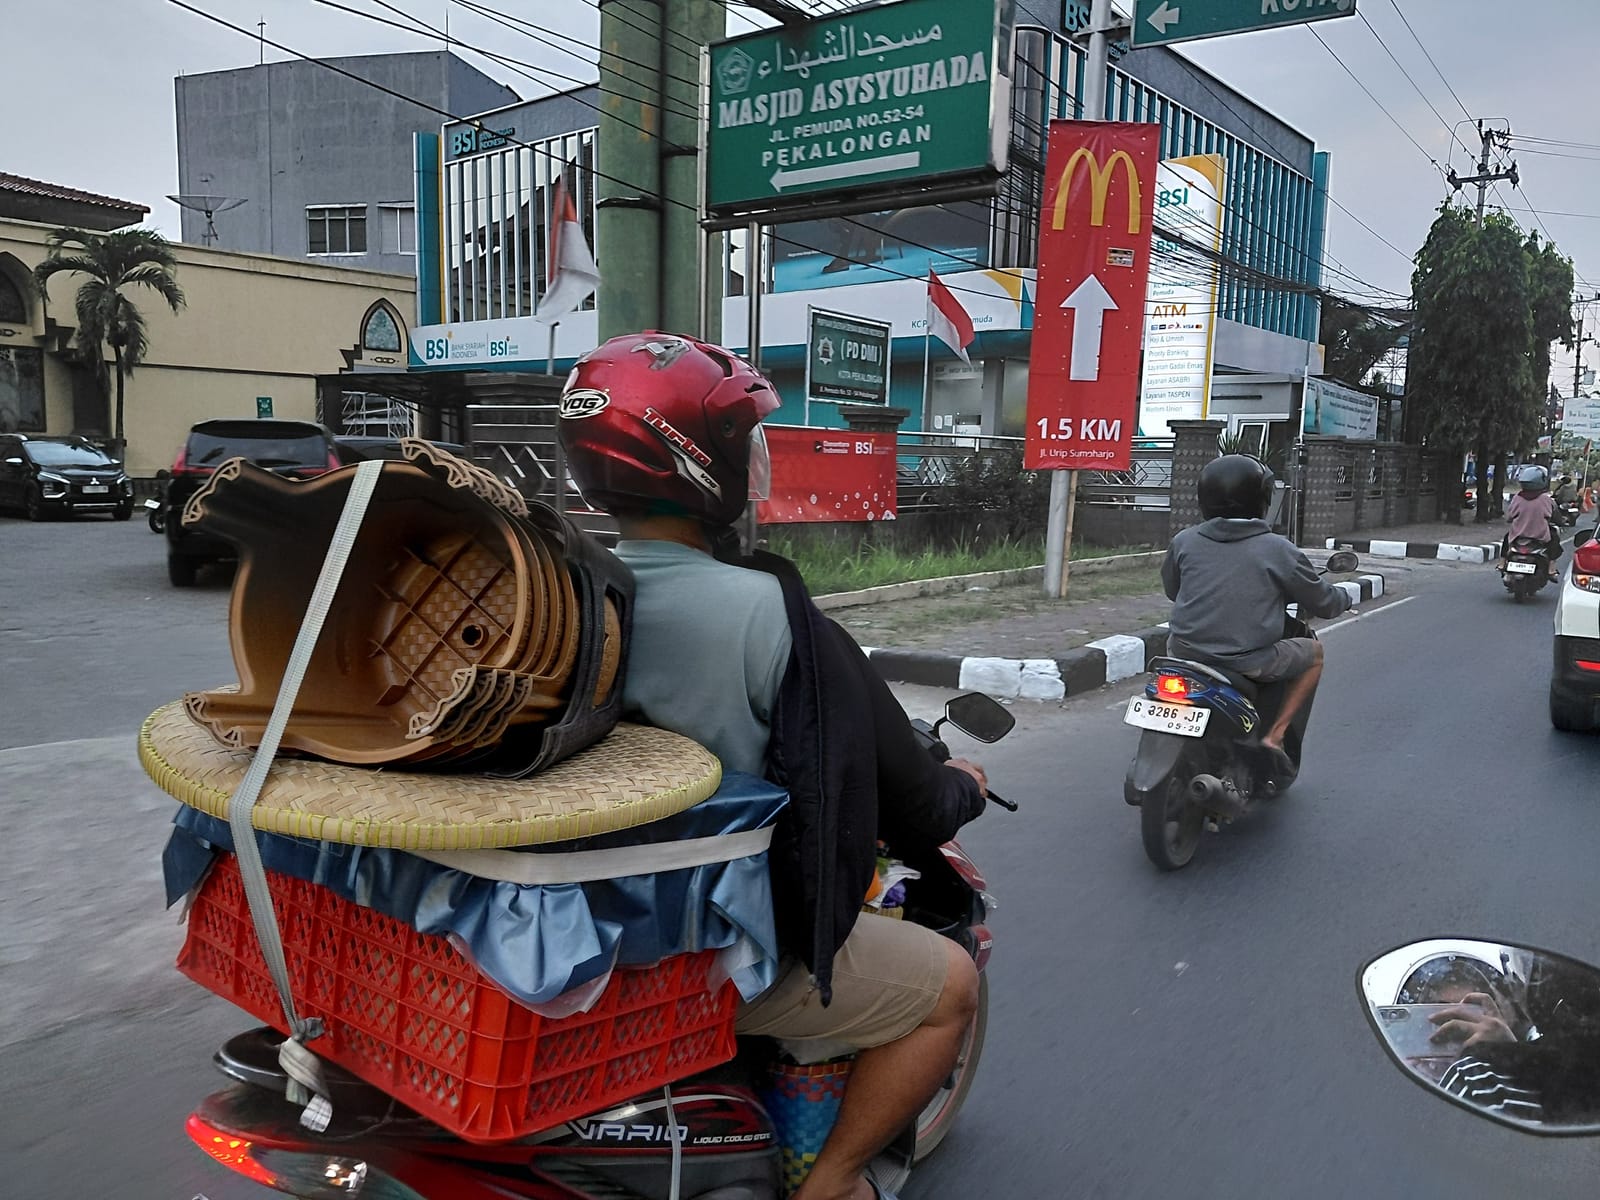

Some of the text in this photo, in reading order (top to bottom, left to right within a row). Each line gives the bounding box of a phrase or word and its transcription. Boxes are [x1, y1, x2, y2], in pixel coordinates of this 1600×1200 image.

[718, 51, 988, 129] MASJID ASYSYUHADA
[769, 104, 925, 143] JL. PEMUDA NO.52-54
[452, 128, 476, 155] BSI
[762, 124, 931, 167] PEKALONGAN
[1158, 188, 1189, 208] BSI
[1152, 303, 1187, 319] ATM
[426, 338, 448, 360] BSI
[490, 341, 508, 357] BSI
[1145, 390, 1191, 400] Layanan TASPEN
[643, 408, 712, 467] Turbo
[1037, 417, 1121, 442] 1.5 KM
[856, 441, 873, 455] BSI
[1070, 449, 1115, 460] Sumoharjo
[1133, 701, 1143, 713] G
[570, 1120, 689, 1141] VARIO
[693, 1136, 723, 1144] LIQUID
